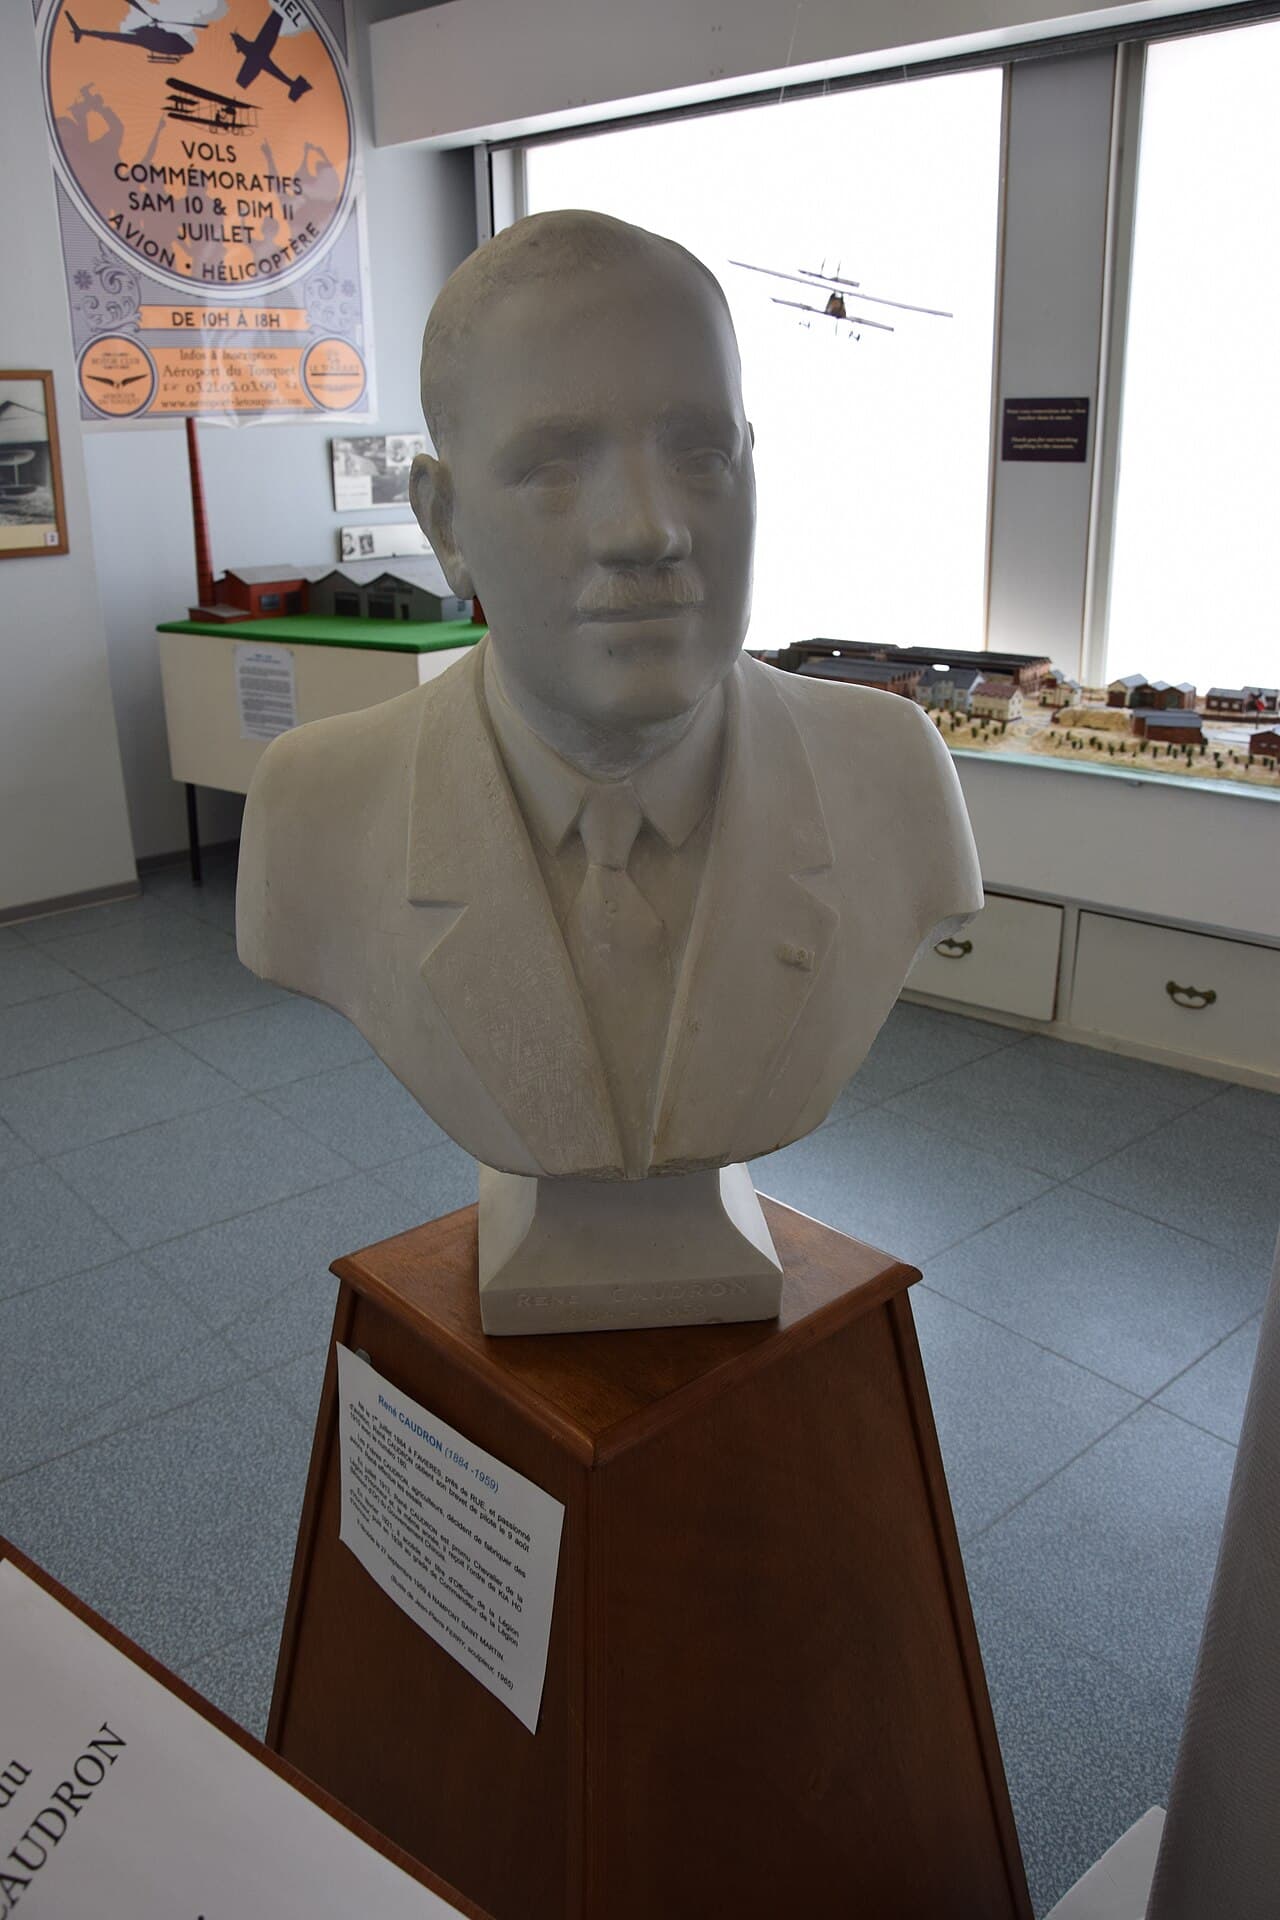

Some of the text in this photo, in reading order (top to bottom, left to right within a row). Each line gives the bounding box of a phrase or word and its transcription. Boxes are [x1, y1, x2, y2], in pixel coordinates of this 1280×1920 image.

[273, 0, 301, 27] IEL
[181, 140, 237, 163] VOLS
[114, 162, 303, 195] COMMÉMORATIFS
[128, 191, 174, 213] SAM
[185, 195, 203, 214] 10
[213, 197, 227, 215] &
[237, 199, 273, 219] DIM
[177, 222, 255, 244] JUILLET
[109, 213, 320, 281] AVION HÉLICOPTÈRE
[171, 309, 280, 328] DE 10H À 18H
[162, 365, 220, 379] Aéroport
[225, 365, 242, 377] du
[248, 365, 295, 378] Touquet
[378, 1395, 397, 1417] René
[399, 1413, 442, 1451] CAUDRON
[444, 1448, 469, 1470] (1884
[469, 1505, 478, 1514] de
[497, 1515, 530, 1542] passionné
[0, 1721, 127, 1920] AUDRON
